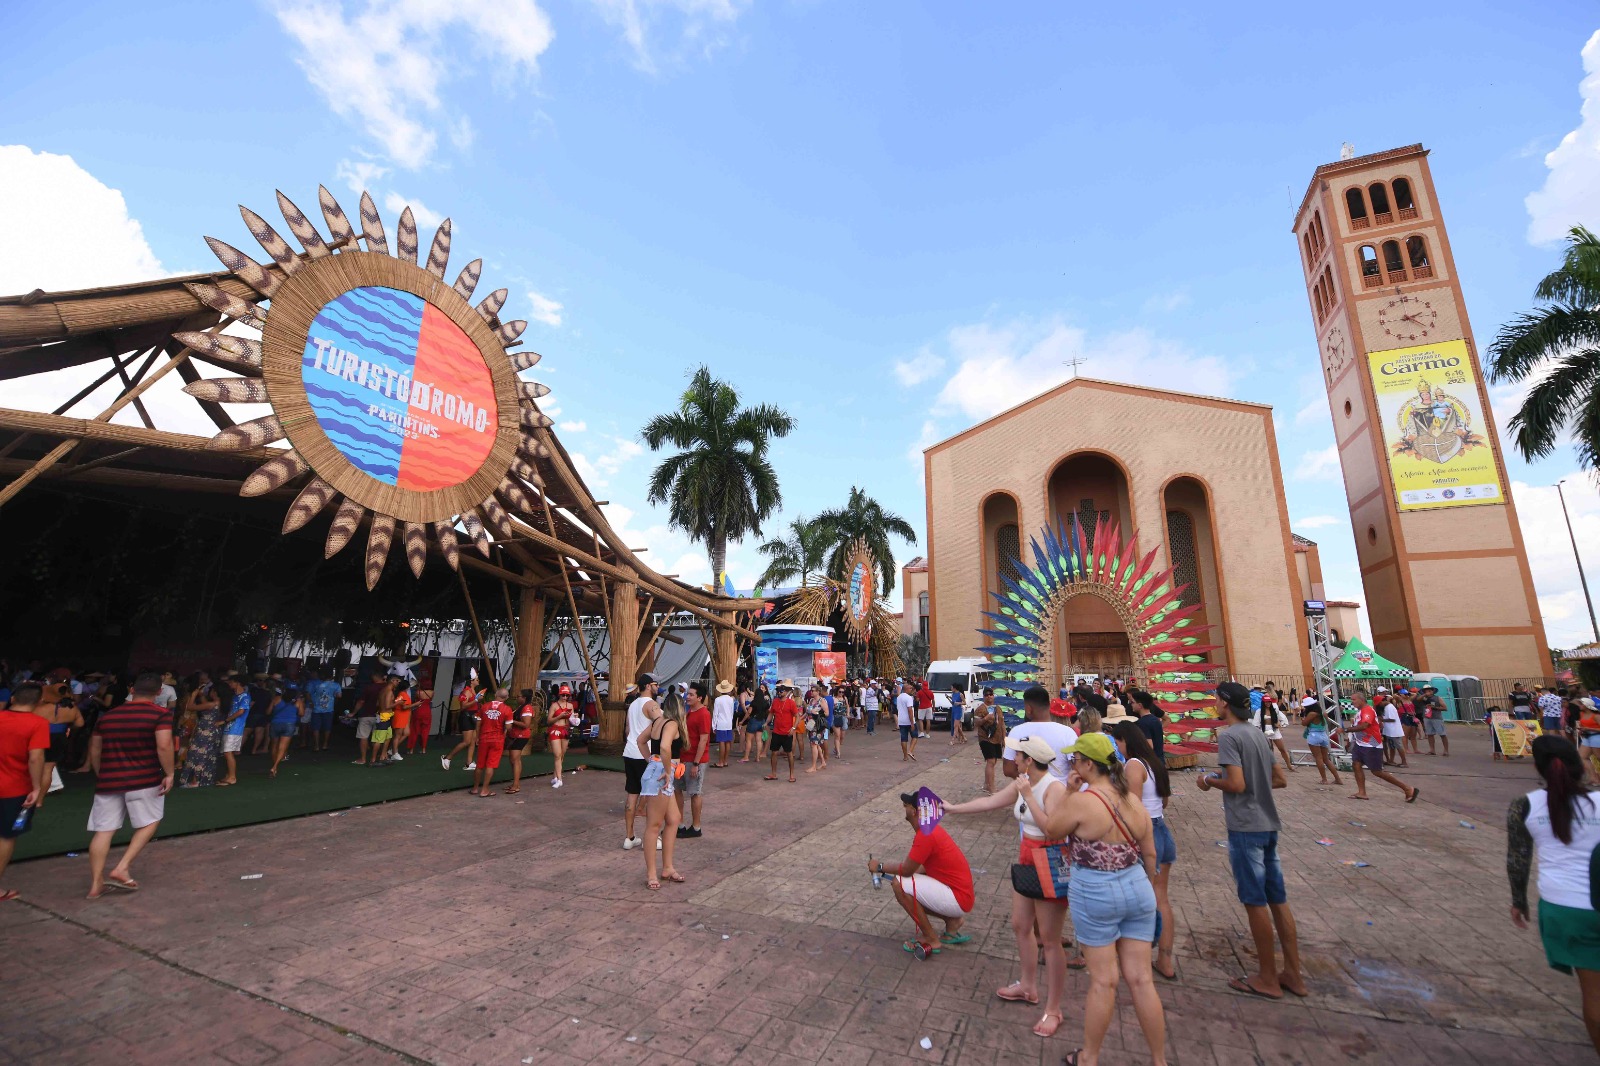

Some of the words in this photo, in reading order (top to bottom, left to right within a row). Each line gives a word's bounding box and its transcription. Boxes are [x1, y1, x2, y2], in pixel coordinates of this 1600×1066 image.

[1380, 357, 1460, 376] Carmo
[313, 337, 491, 433] TURISTÓDROMO
[367, 403, 441, 439] PARINTINS
[388, 424, 419, 440] 2023
